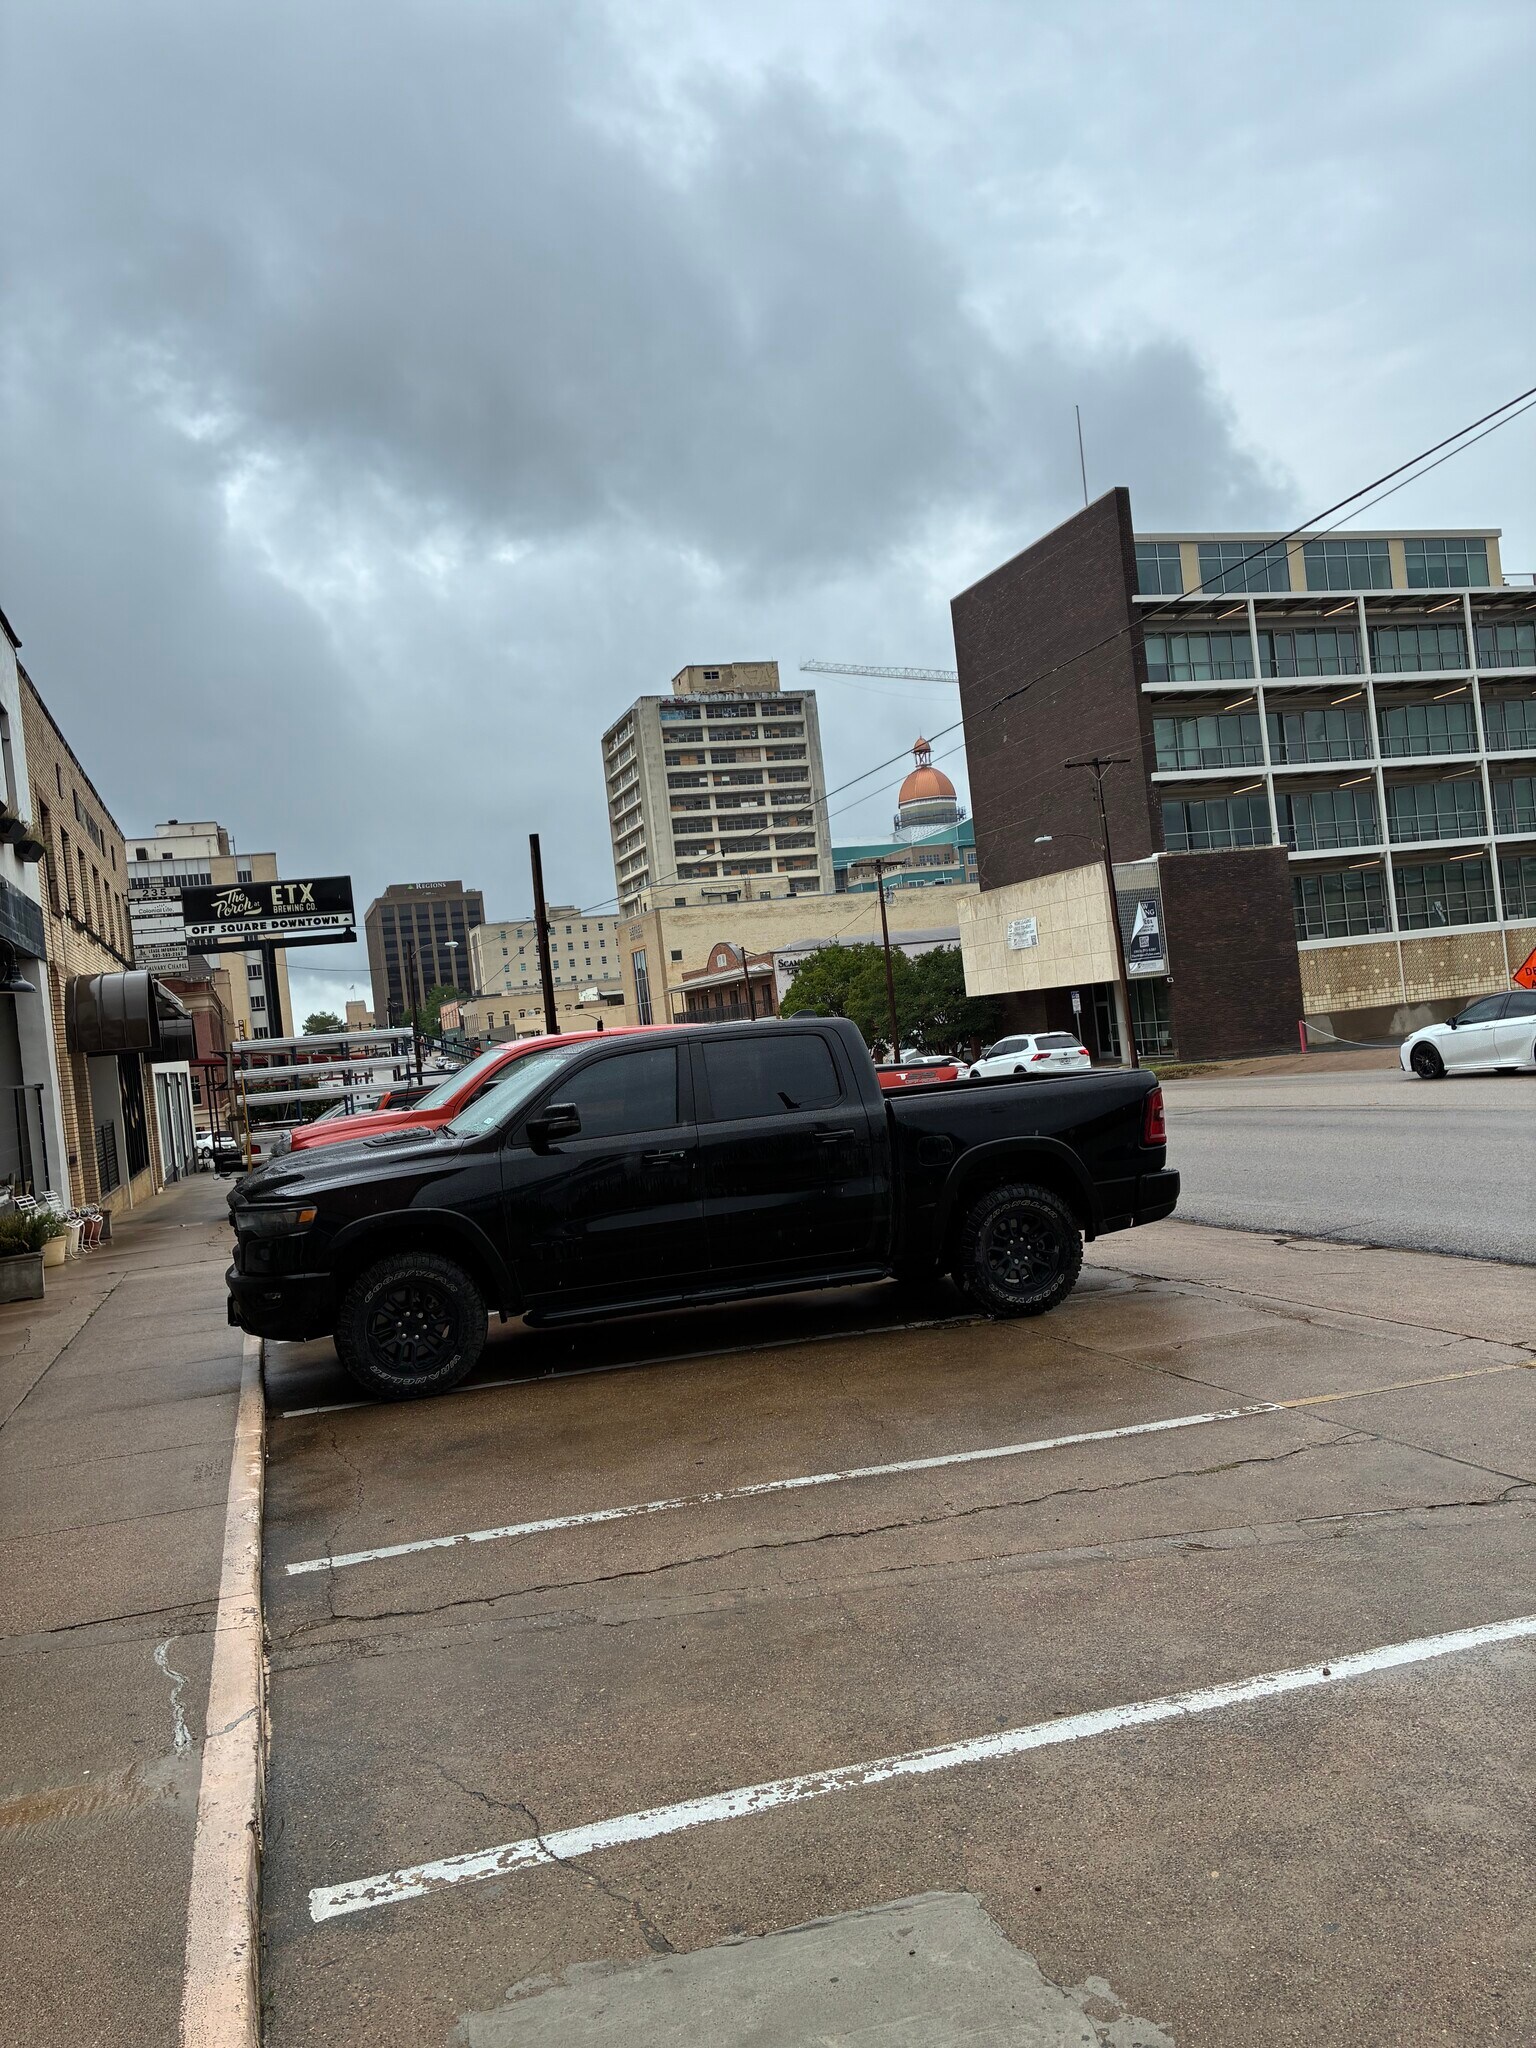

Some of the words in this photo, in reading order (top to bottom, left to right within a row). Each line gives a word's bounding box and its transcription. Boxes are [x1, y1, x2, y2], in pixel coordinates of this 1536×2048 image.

[142, 888, 167, 897] 235
[216, 888, 245, 904] The
[271, 883, 315, 905] ETX
[415, 882, 446, 890] REGIONS
[138, 906, 161, 914] Colonial
[211, 896, 262, 918] Porch
[273, 903, 304, 914] BREWING
[306, 902, 317, 911] CO.
[192, 925, 215, 934] OFF
[221, 921, 267, 932] SQUARE
[271, 916, 339, 929] DOWNTOWN
[984, 1200, 1058, 1227] WRANGLER
[365, 1270, 458, 1303] GOODYEAR
[988, 1273, 1065, 1303] GOODYEAR
[370, 1354, 461, 1385] WRANGLER
